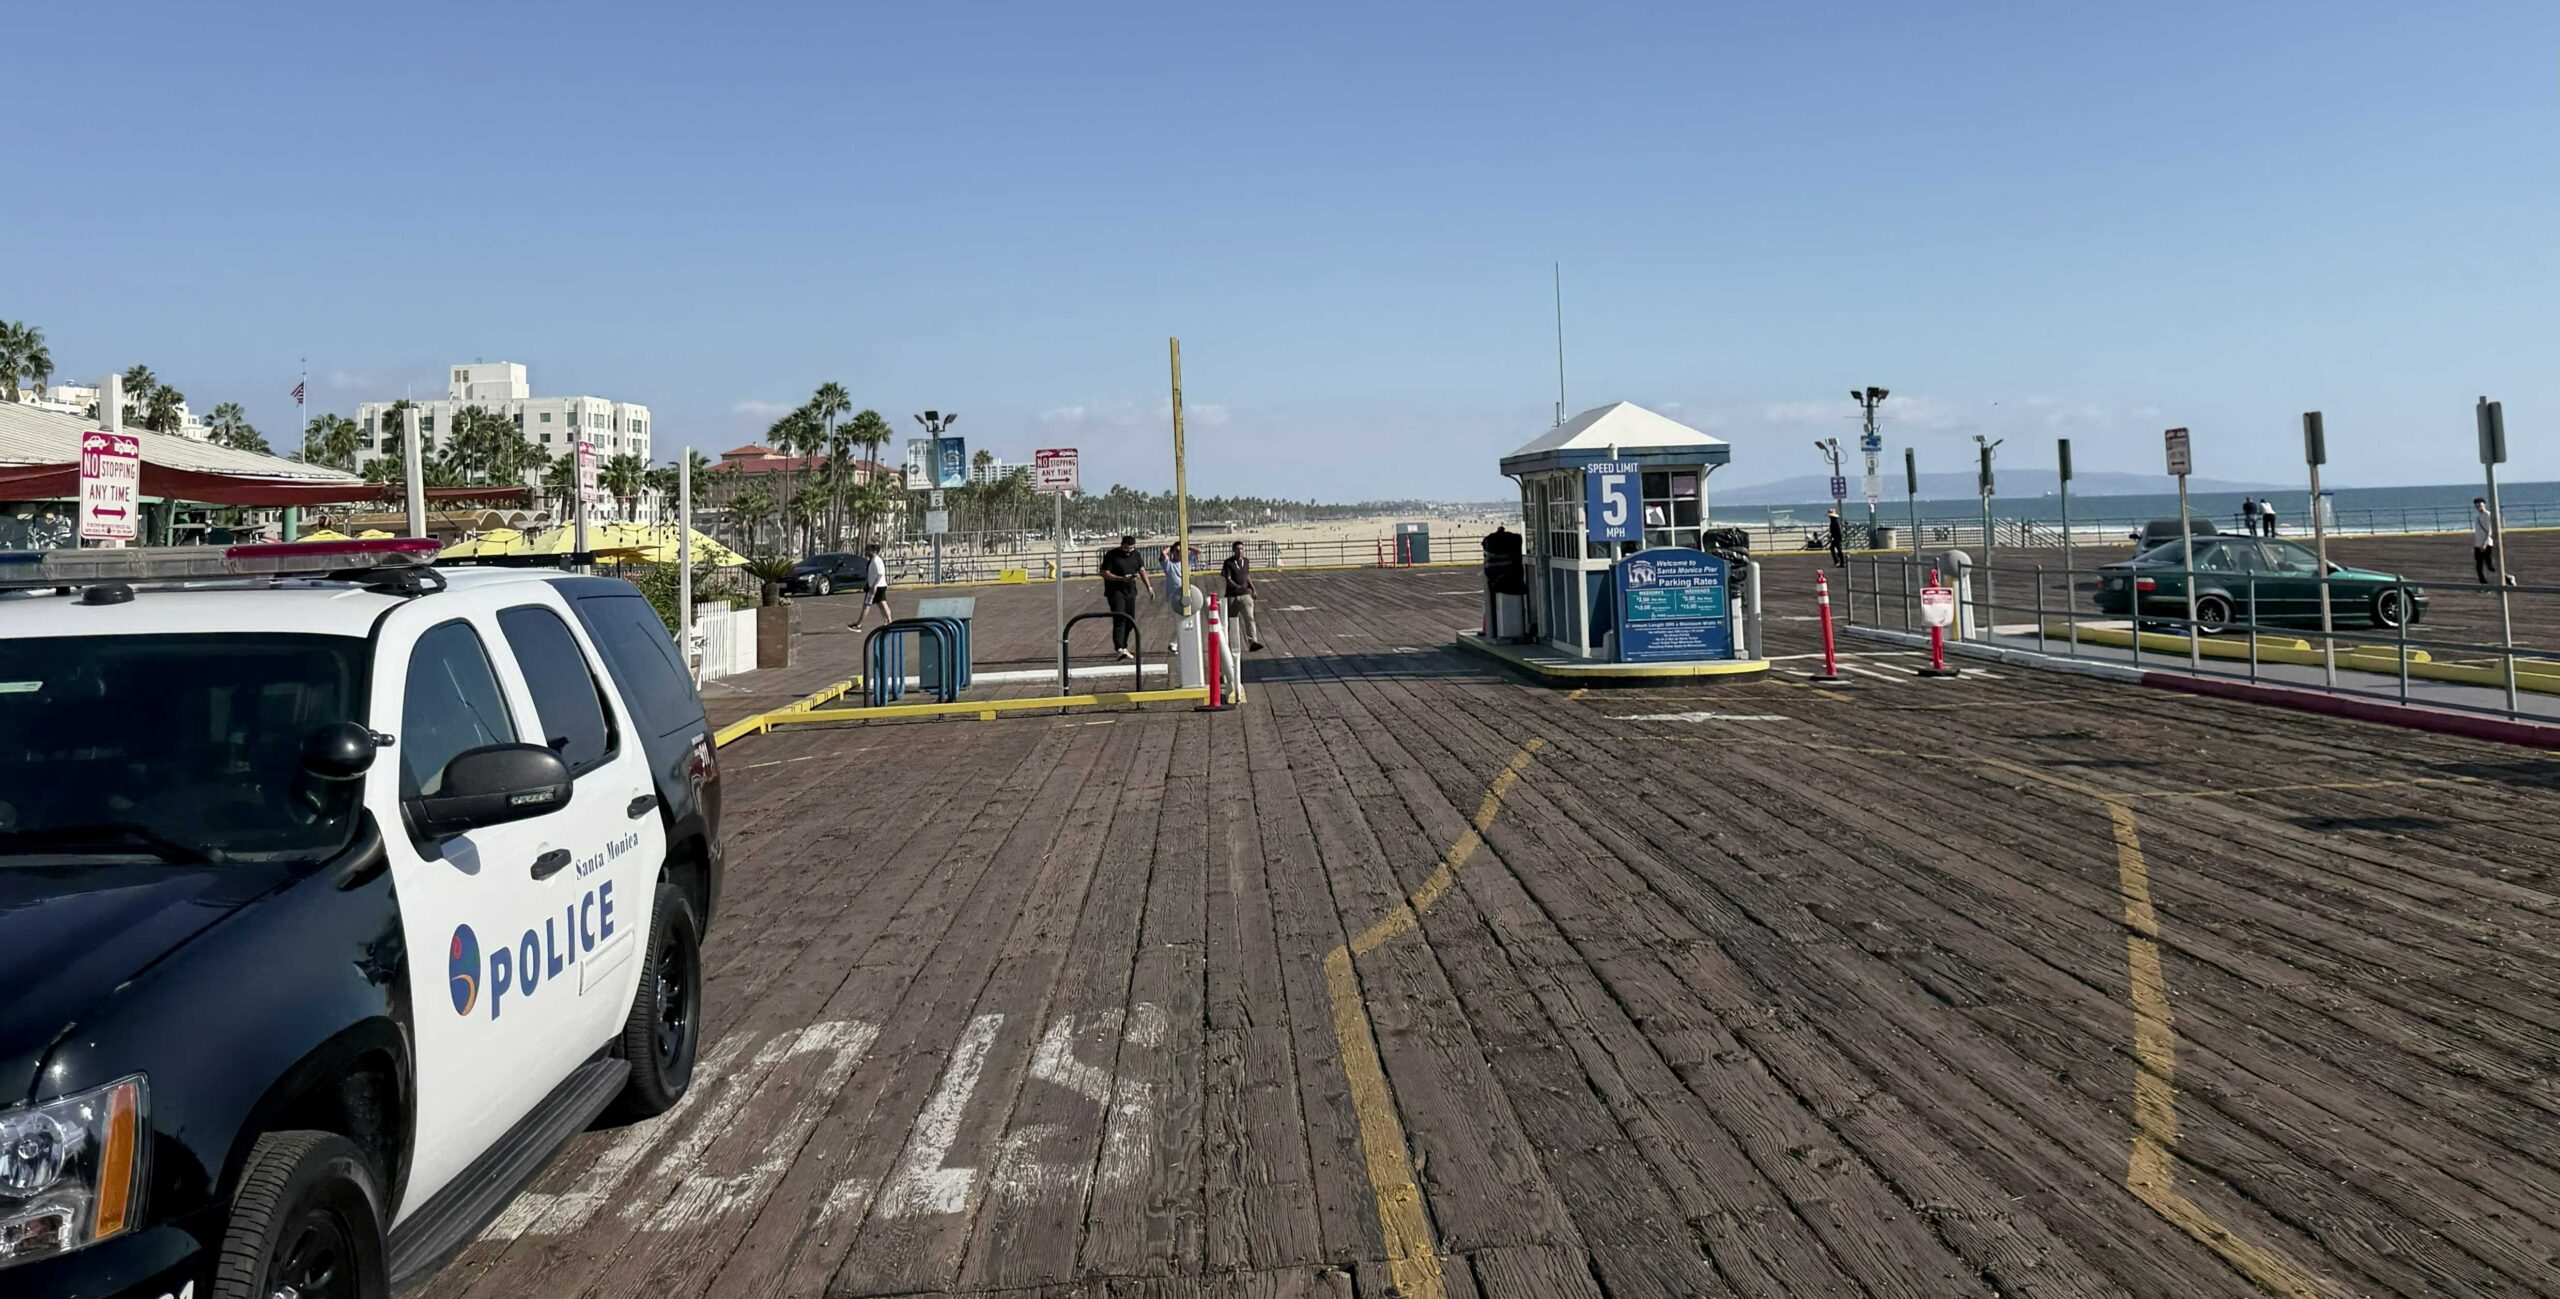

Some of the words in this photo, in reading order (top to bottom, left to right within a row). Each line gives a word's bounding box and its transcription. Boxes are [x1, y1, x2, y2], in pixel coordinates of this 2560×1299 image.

[83, 452, 99, 477] NO
[101, 460, 136, 479] STOPPING
[1037, 457, 1049, 468] NO
[1050, 459, 1076, 467] STOPPING
[1587, 463, 1614, 474] SPEED
[1616, 463, 1639, 473] LIMIT
[89, 484, 108, 500] ANY
[111, 485, 130, 502] TIME
[1602, 475, 1627, 526] 5
[1606, 527, 1626, 538] MPH
[1658, 578, 1692, 588] Parking
[1693, 578, 1718, 586] Rates
[575, 851, 605, 880] Santa
[606, 832, 639, 863] Monica
[490, 879, 614, 1021] POLICE
